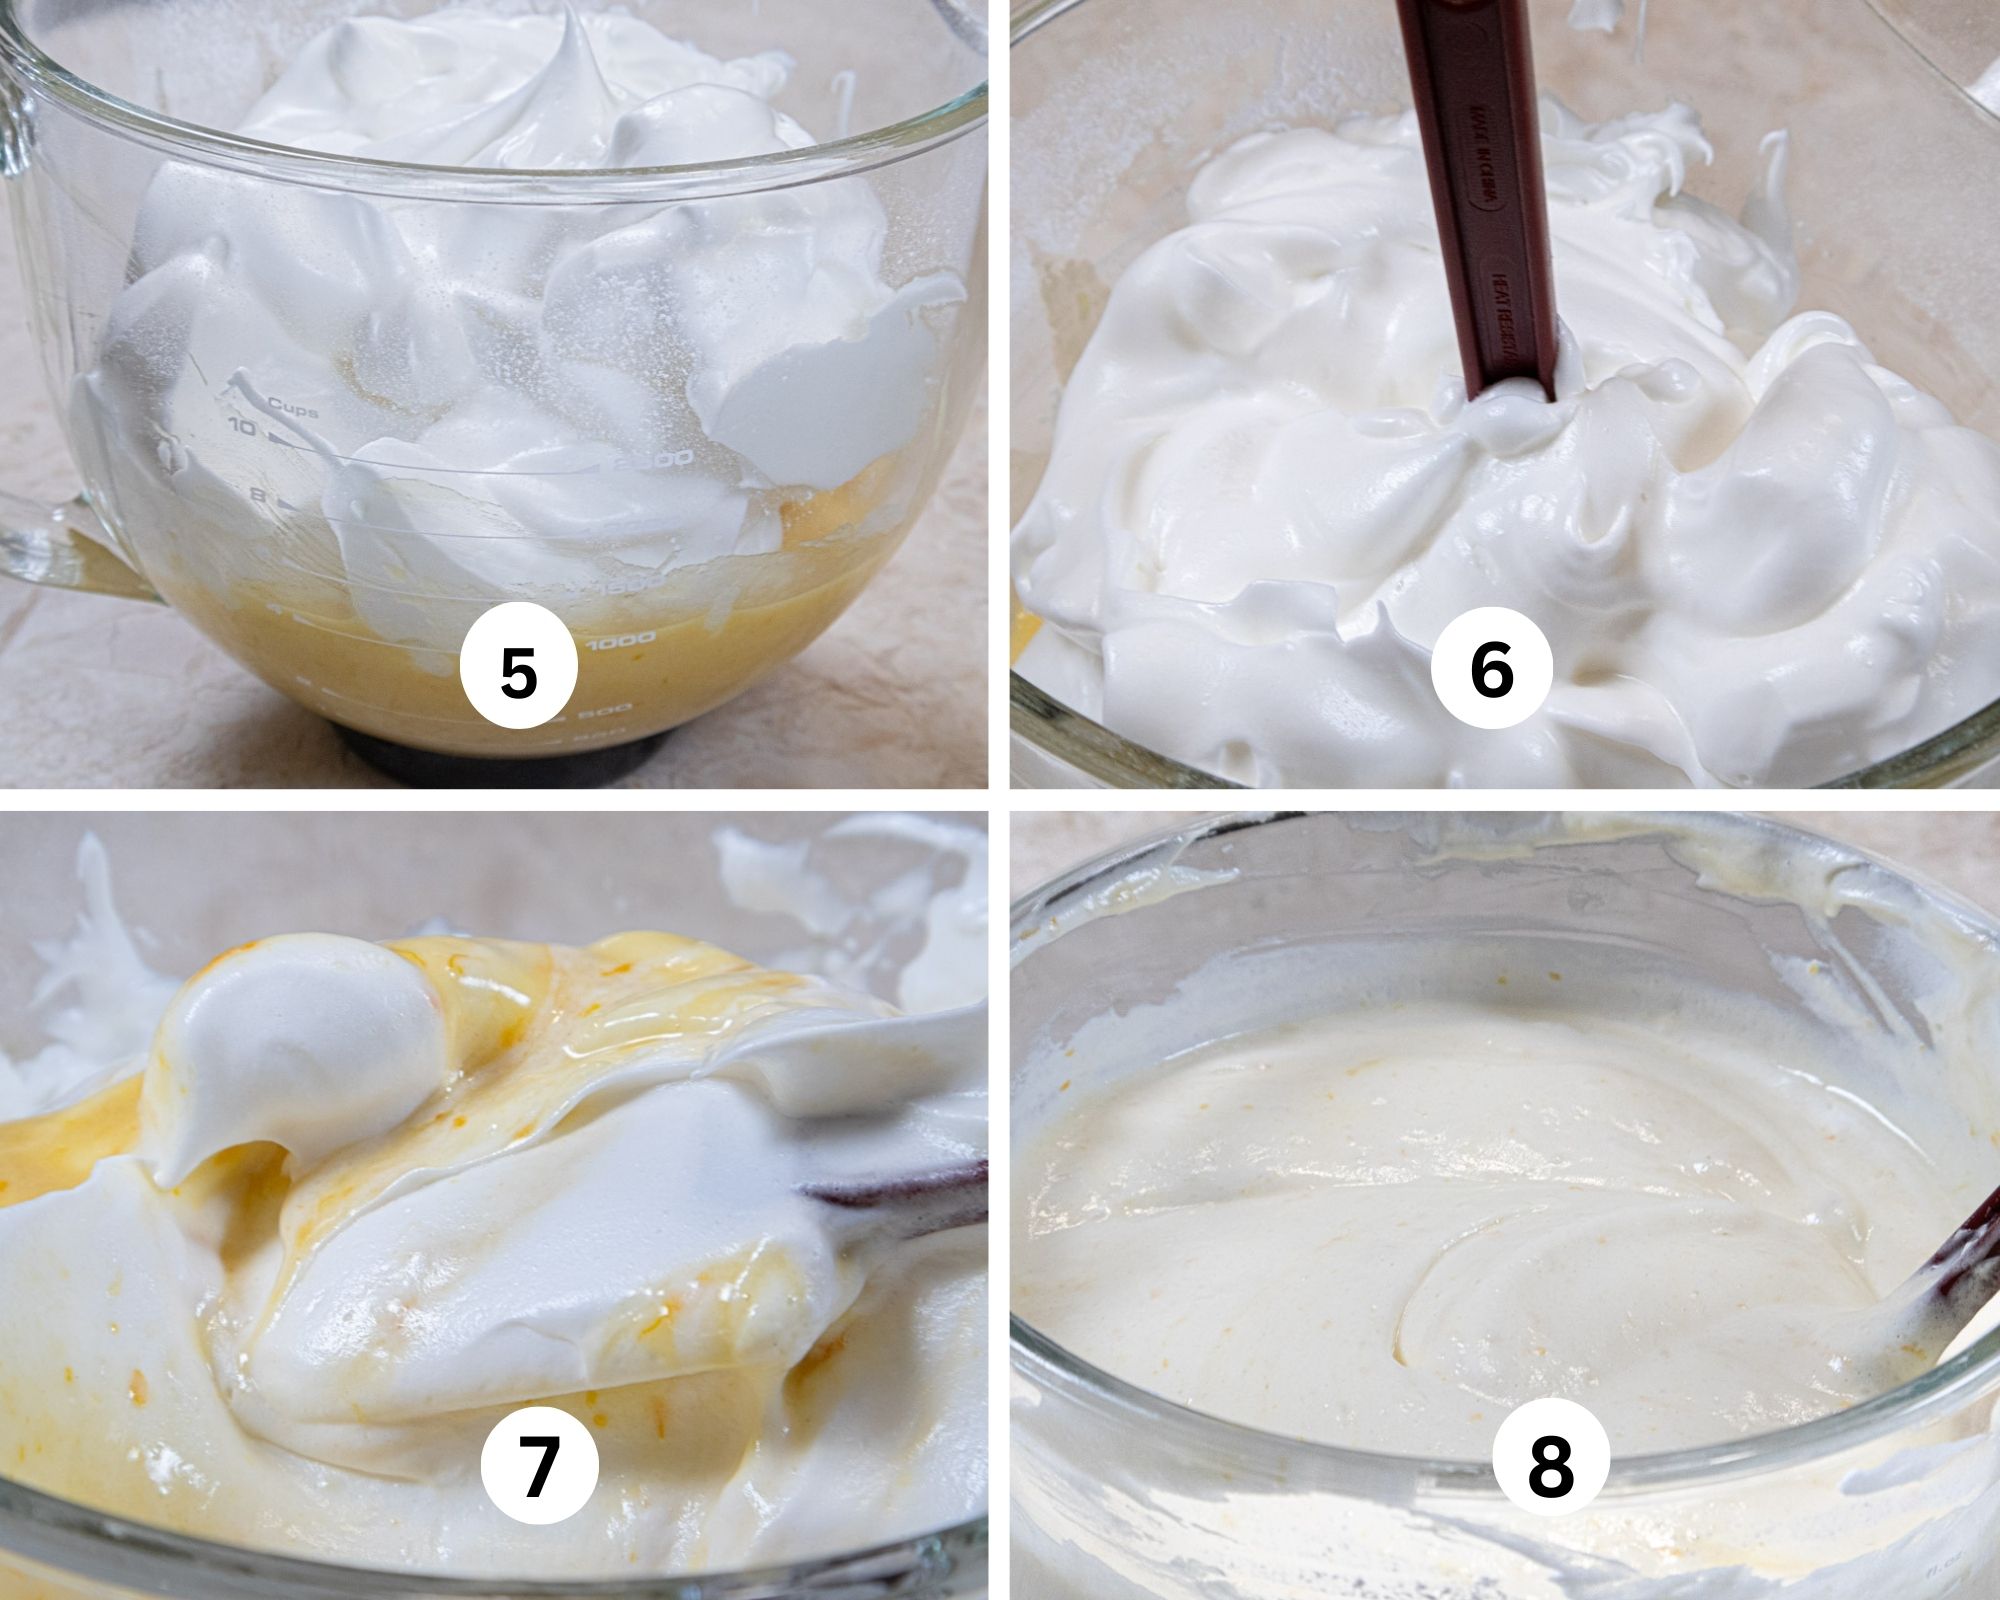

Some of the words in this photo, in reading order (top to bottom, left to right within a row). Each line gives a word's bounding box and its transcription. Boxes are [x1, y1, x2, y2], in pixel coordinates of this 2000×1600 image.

[1477, 147, 1492, 162] IN
[1492, 273, 1512, 307] HEAT
[267, 396, 319, 419] Cups
[228, 416, 257, 437] 10
[249, 486, 267, 503] 8
[584, 629, 658, 651] 1000
